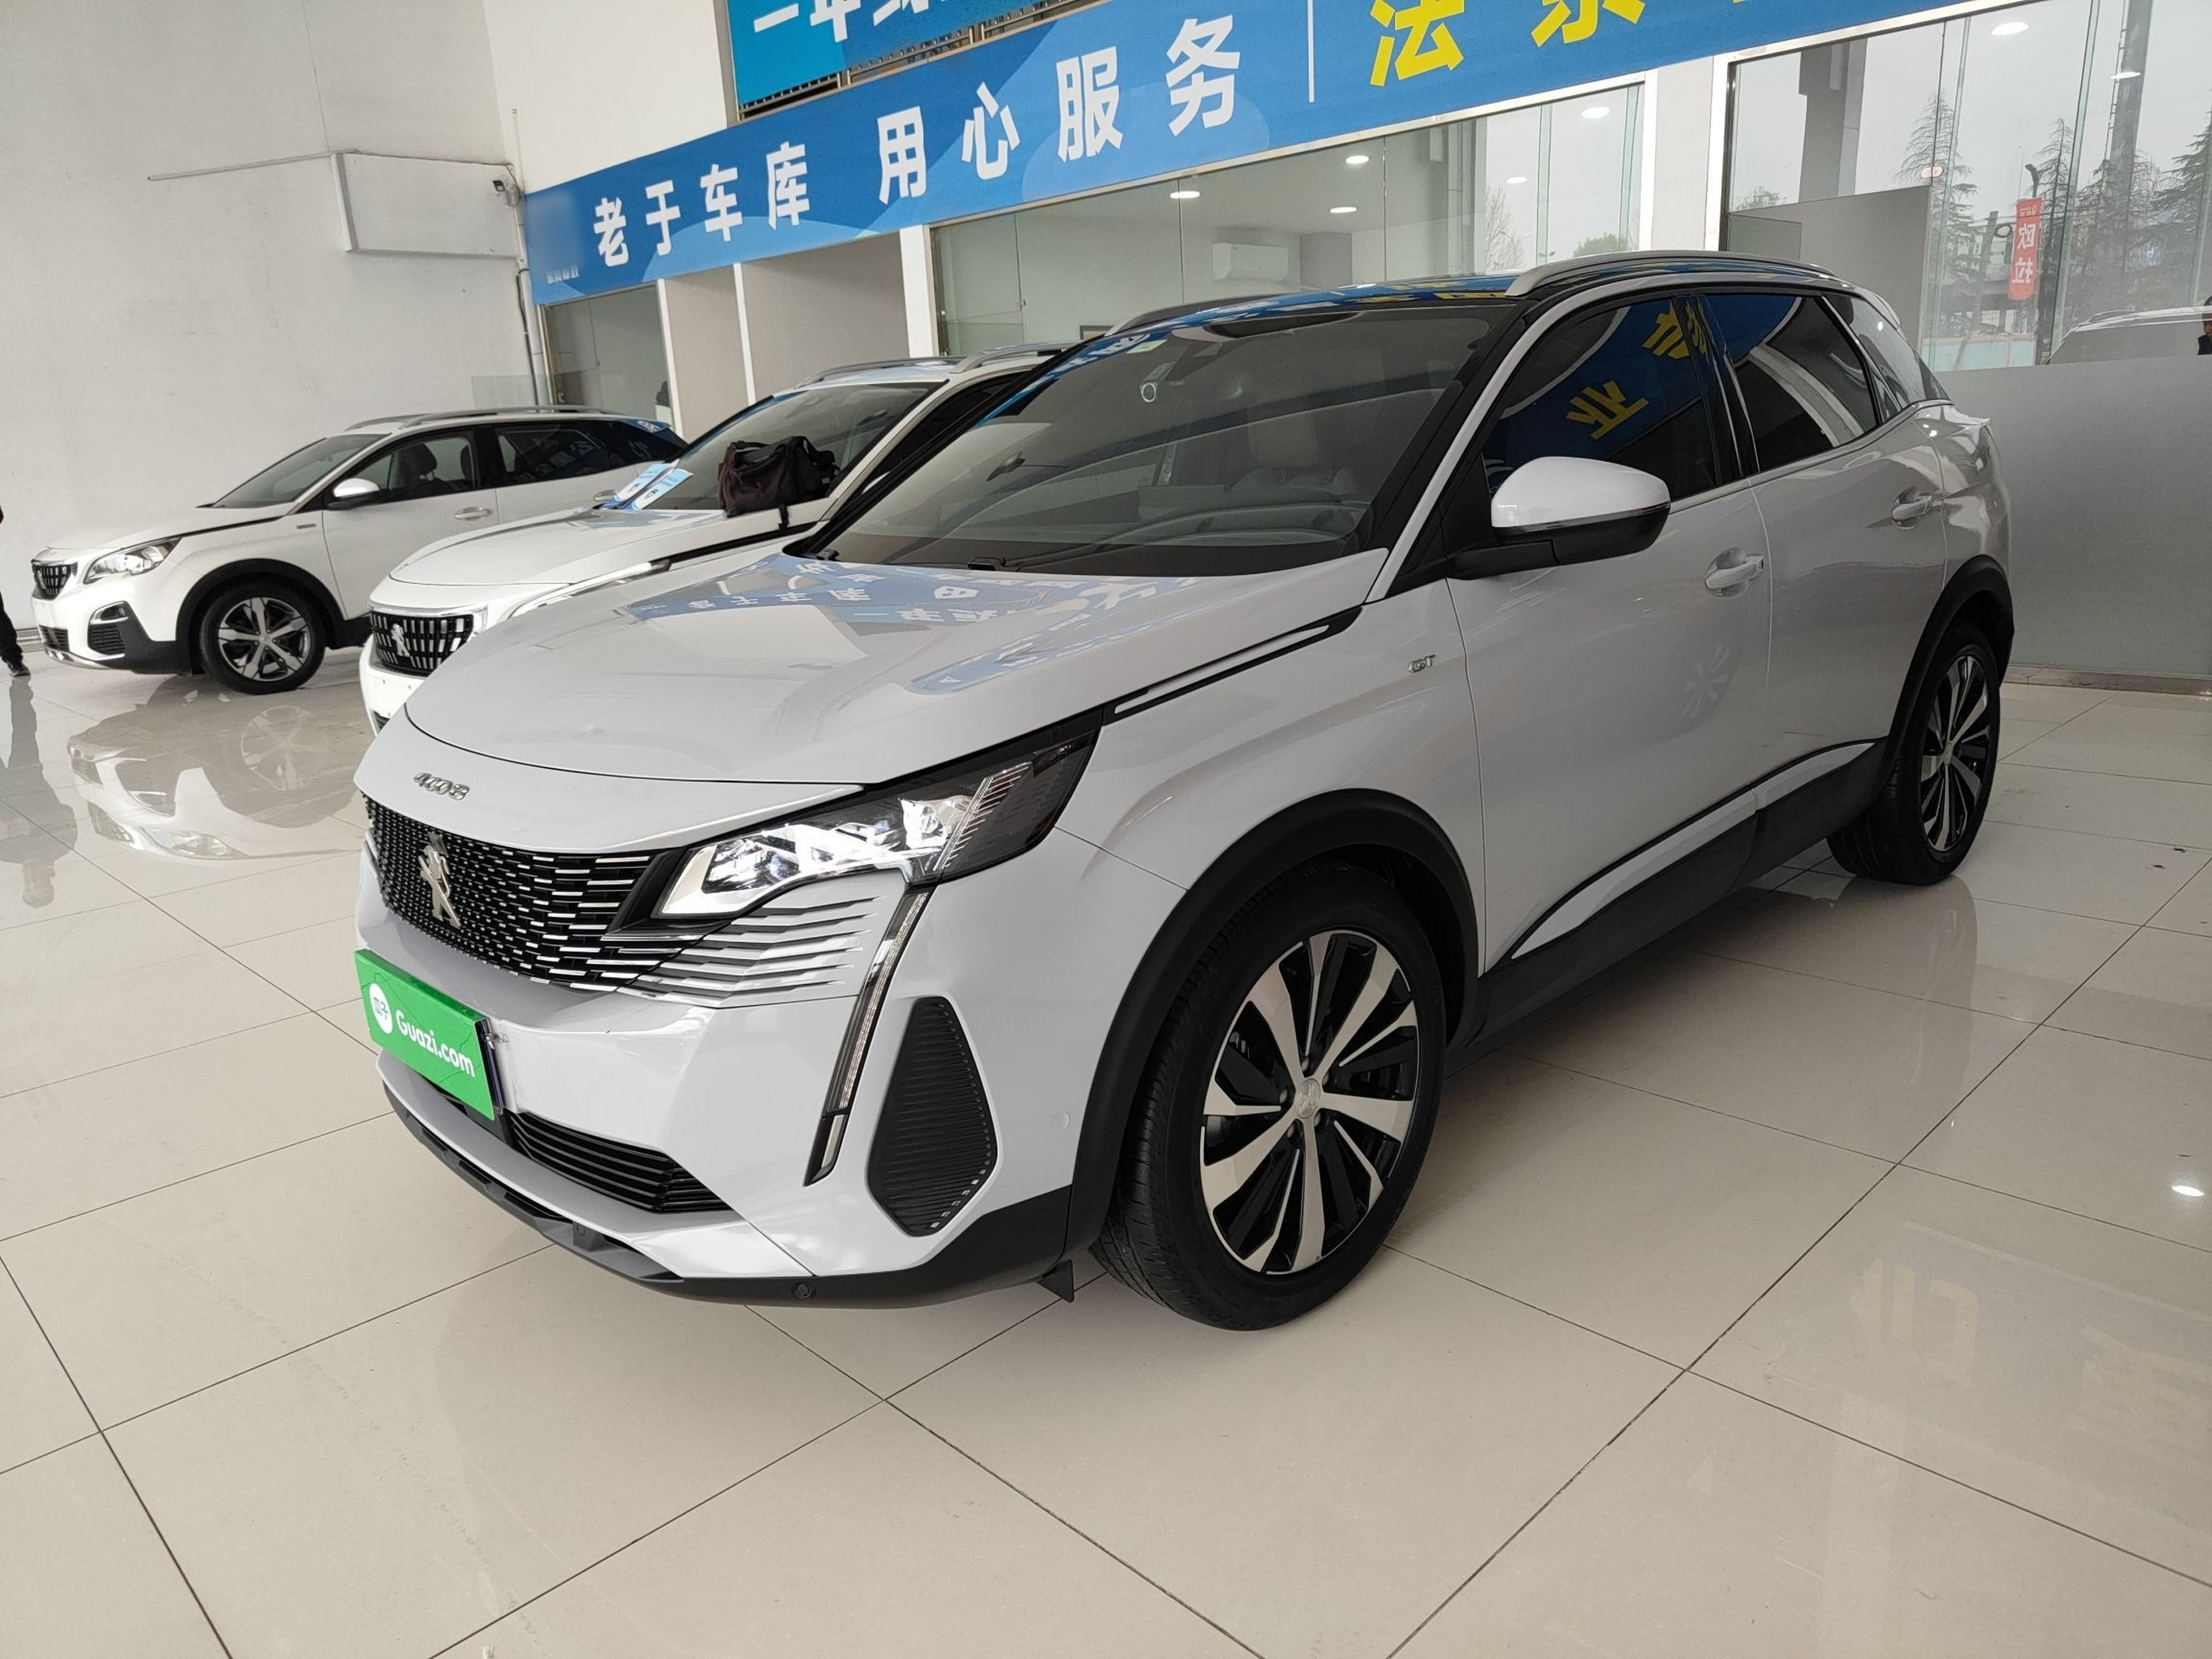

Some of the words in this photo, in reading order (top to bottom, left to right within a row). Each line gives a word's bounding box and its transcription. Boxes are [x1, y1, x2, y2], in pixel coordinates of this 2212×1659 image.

[593, 141, 810, 267] 老于车库
[878, 14, 1241, 205] 用心服务
[413, 772, 470, 801] 4008
[396, 1009, 476, 1078] Guazi.com
